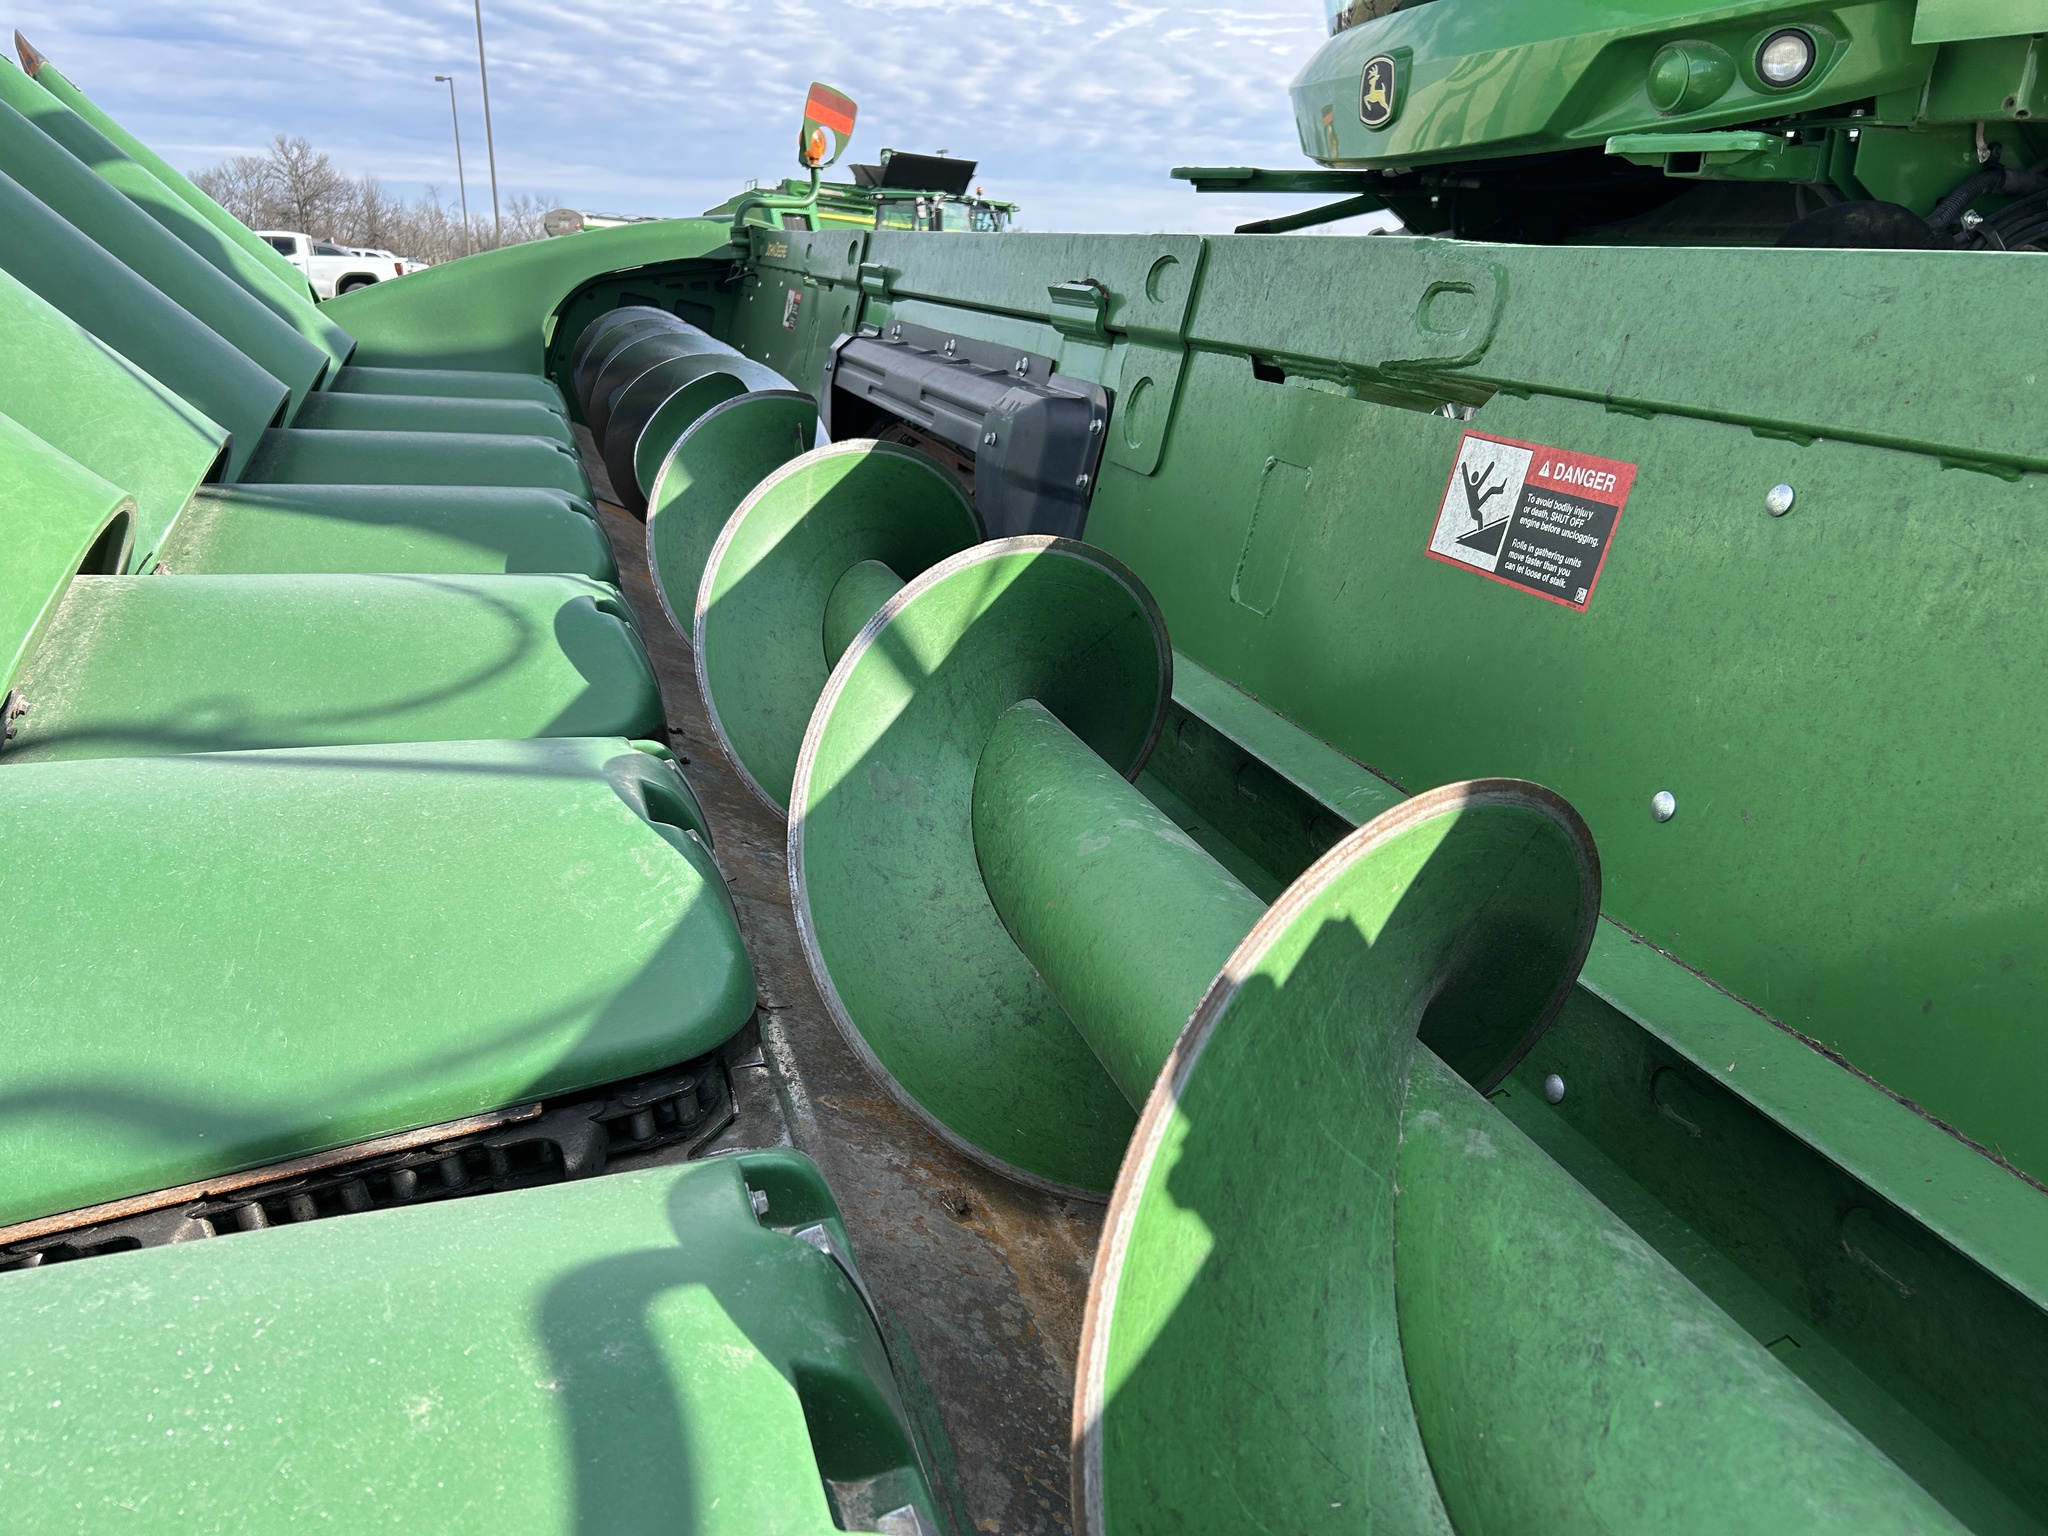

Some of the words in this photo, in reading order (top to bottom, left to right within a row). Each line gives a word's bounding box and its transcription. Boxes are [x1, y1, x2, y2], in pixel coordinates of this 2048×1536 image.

[1553, 463, 1616, 492] DANGER
[1528, 493, 1536, 503] To
[1536, 496, 1554, 508] avoid
[1553, 500, 1574, 515] bodily
[1574, 506, 1594, 520] injury
[1531, 506, 1549, 521] death,
[1550, 512, 1570, 525] SHUT
[1570, 516, 1585, 528] OFF
[1520, 516, 1540, 528] engine
[1540, 522, 1561, 535] before
[1561, 528, 1599, 548] unclogging.
[1508, 550, 1524, 562] move
[1525, 554, 1544, 568] faster
[1543, 560, 1558, 573] than
[1557, 567, 1572, 577] you
[1512, 538, 1528, 550] Rolls
[1528, 544, 1534, 552] in
[1534, 548, 1564, 564] gathering
[1564, 556, 1582, 568] units
[1504, 562, 1516, 571] can
[1516, 564, 1524, 574] let
[1524, 566, 1542, 580] loose
[1542, 574, 1550, 582] of
[1549, 576, 1566, 588] stalk.
